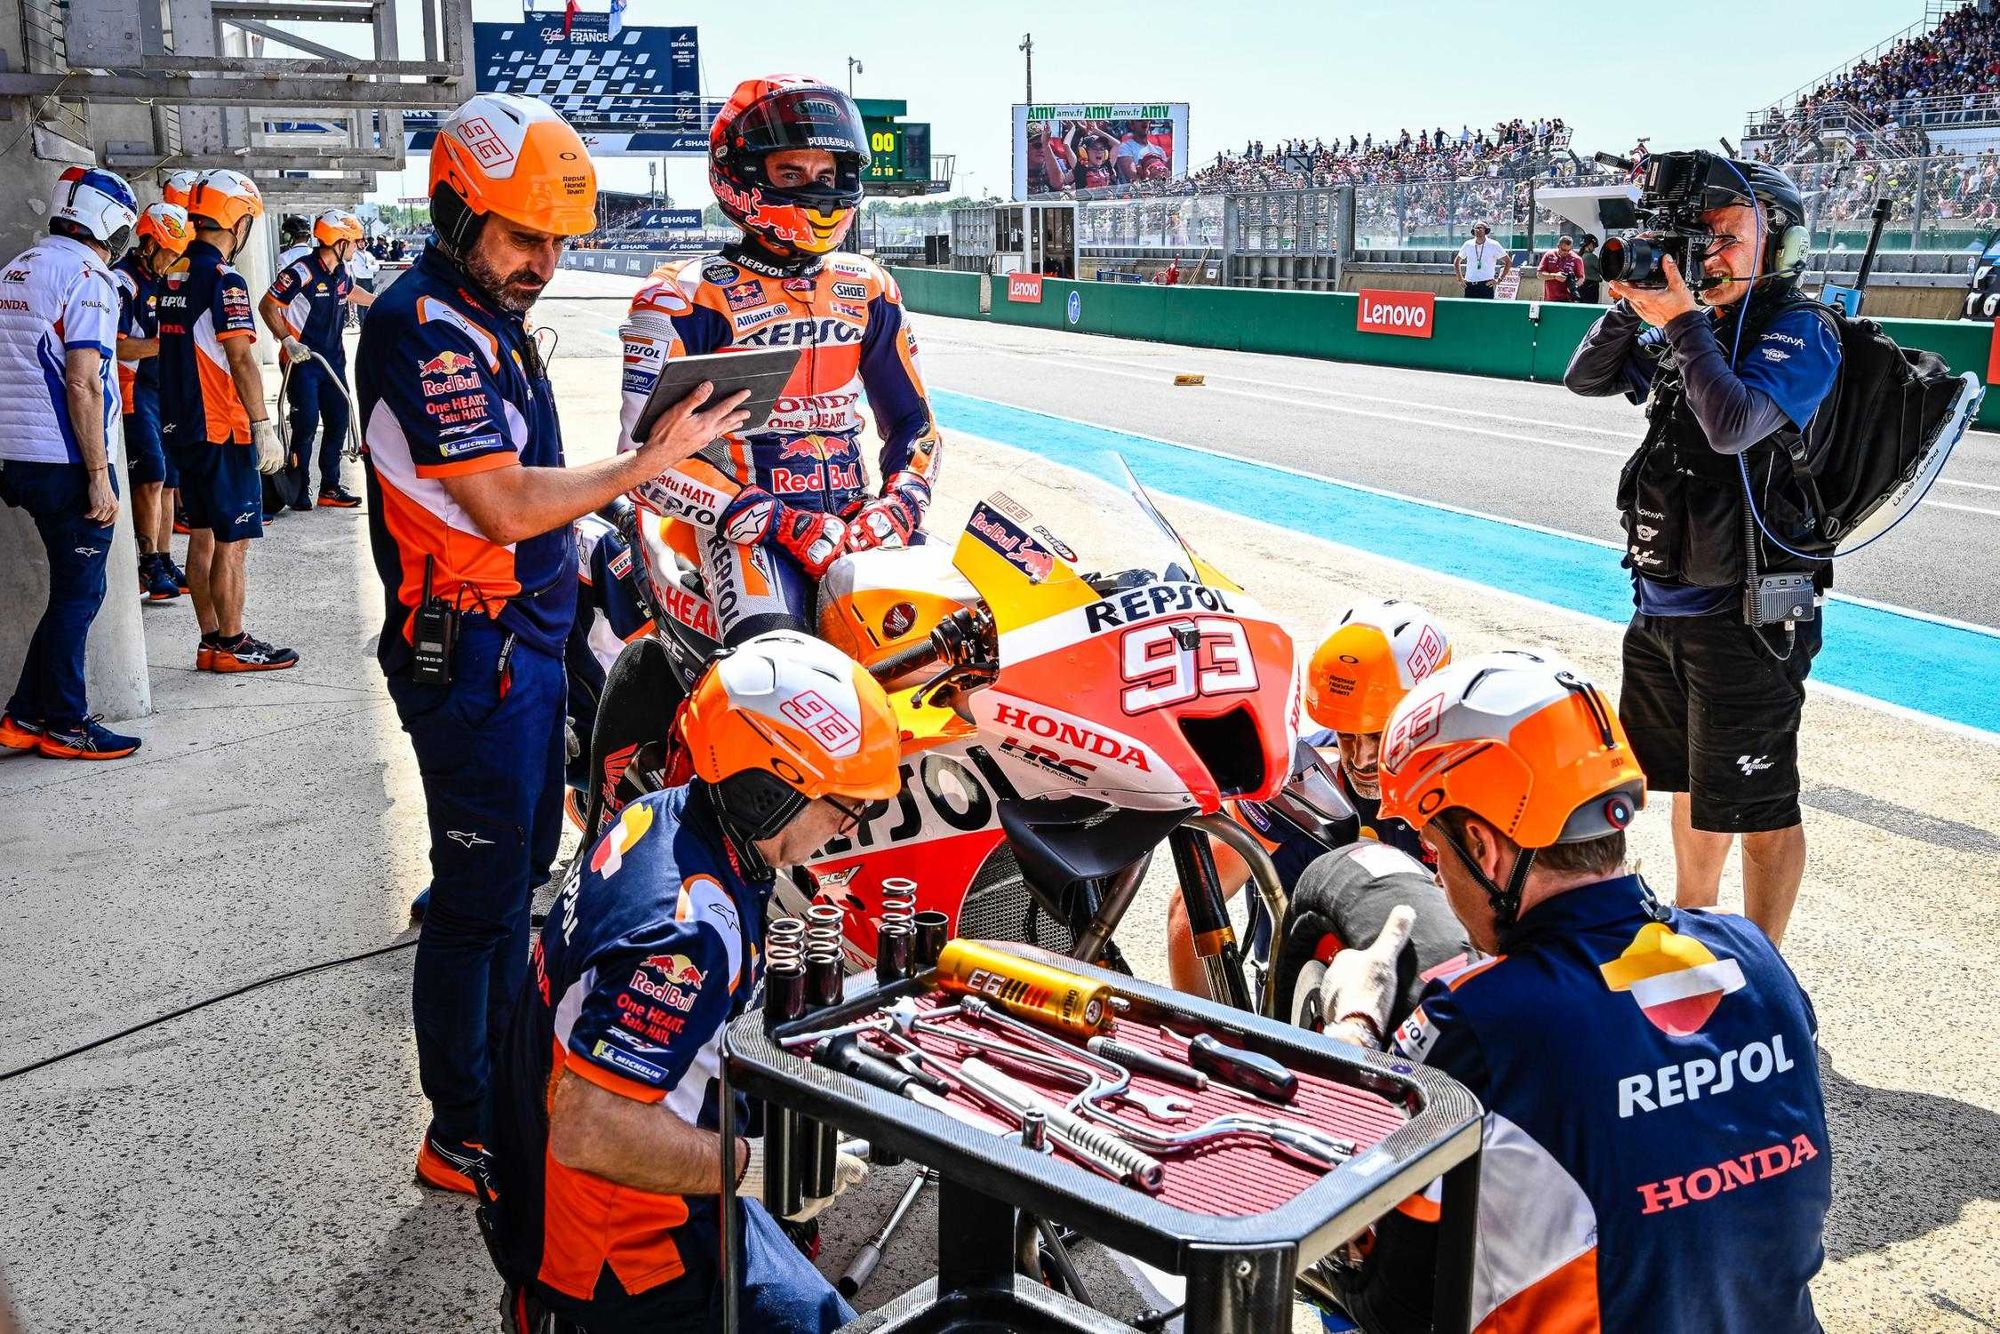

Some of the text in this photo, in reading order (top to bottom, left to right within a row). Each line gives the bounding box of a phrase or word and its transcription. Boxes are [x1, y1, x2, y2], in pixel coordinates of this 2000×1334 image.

[570, 32, 608, 43] FRANCE
[799, 101, 836, 116] SHOEI
[1056, 108, 1084, 118] amv.fr
[1113, 108, 1140, 117] amv.fr
[808, 137, 856, 149] PULL&BEAR
[872, 132, 894, 151] 00
[4, 270, 31, 281] HRC
[737, 255, 785, 277] REPSOL
[834, 263, 868, 274] REPSOL
[838, 287, 866, 298] SHOEI
[1010, 281, 1040, 298] Lenovo
[729, 293, 768, 311] Red Bull
[1364, 298, 1426, 328] Lenovo
[737, 309, 772, 328] Allianz
[736, 319, 865, 346] REPSOL
[1760, 332, 1806, 350] DORNA
[624, 344, 660, 359] EPSOL
[422, 371, 481, 396] Red Bull
[426, 394, 489, 415] One HEART.
[438, 406, 487, 424] Satu HATI.
[459, 438, 496, 450] MICHELIN
[771, 462, 862, 494] Red Bull
[681, 482, 717, 509] HATI.
[970, 511, 1021, 552] Red Bull
[707, 534, 740, 635] REPSOL
[1085, 584, 1235, 634] REPSOL
[1120, 615, 1261, 717] 93
[993, 702, 1152, 774] HONDA
[1000, 736, 1098, 782] HRC
[1041, 765, 1087, 788] RACING
[629, 969, 698, 1013] Red Bull
[617, 992, 686, 1035] One HEART.
[620, 1011, 671, 1046] Satu HATI.
[615, 1052, 663, 1080] MICHELIN
[1618, 1033, 1794, 1118] REPSOL
[1635, 1132, 1818, 1215] HONDA
